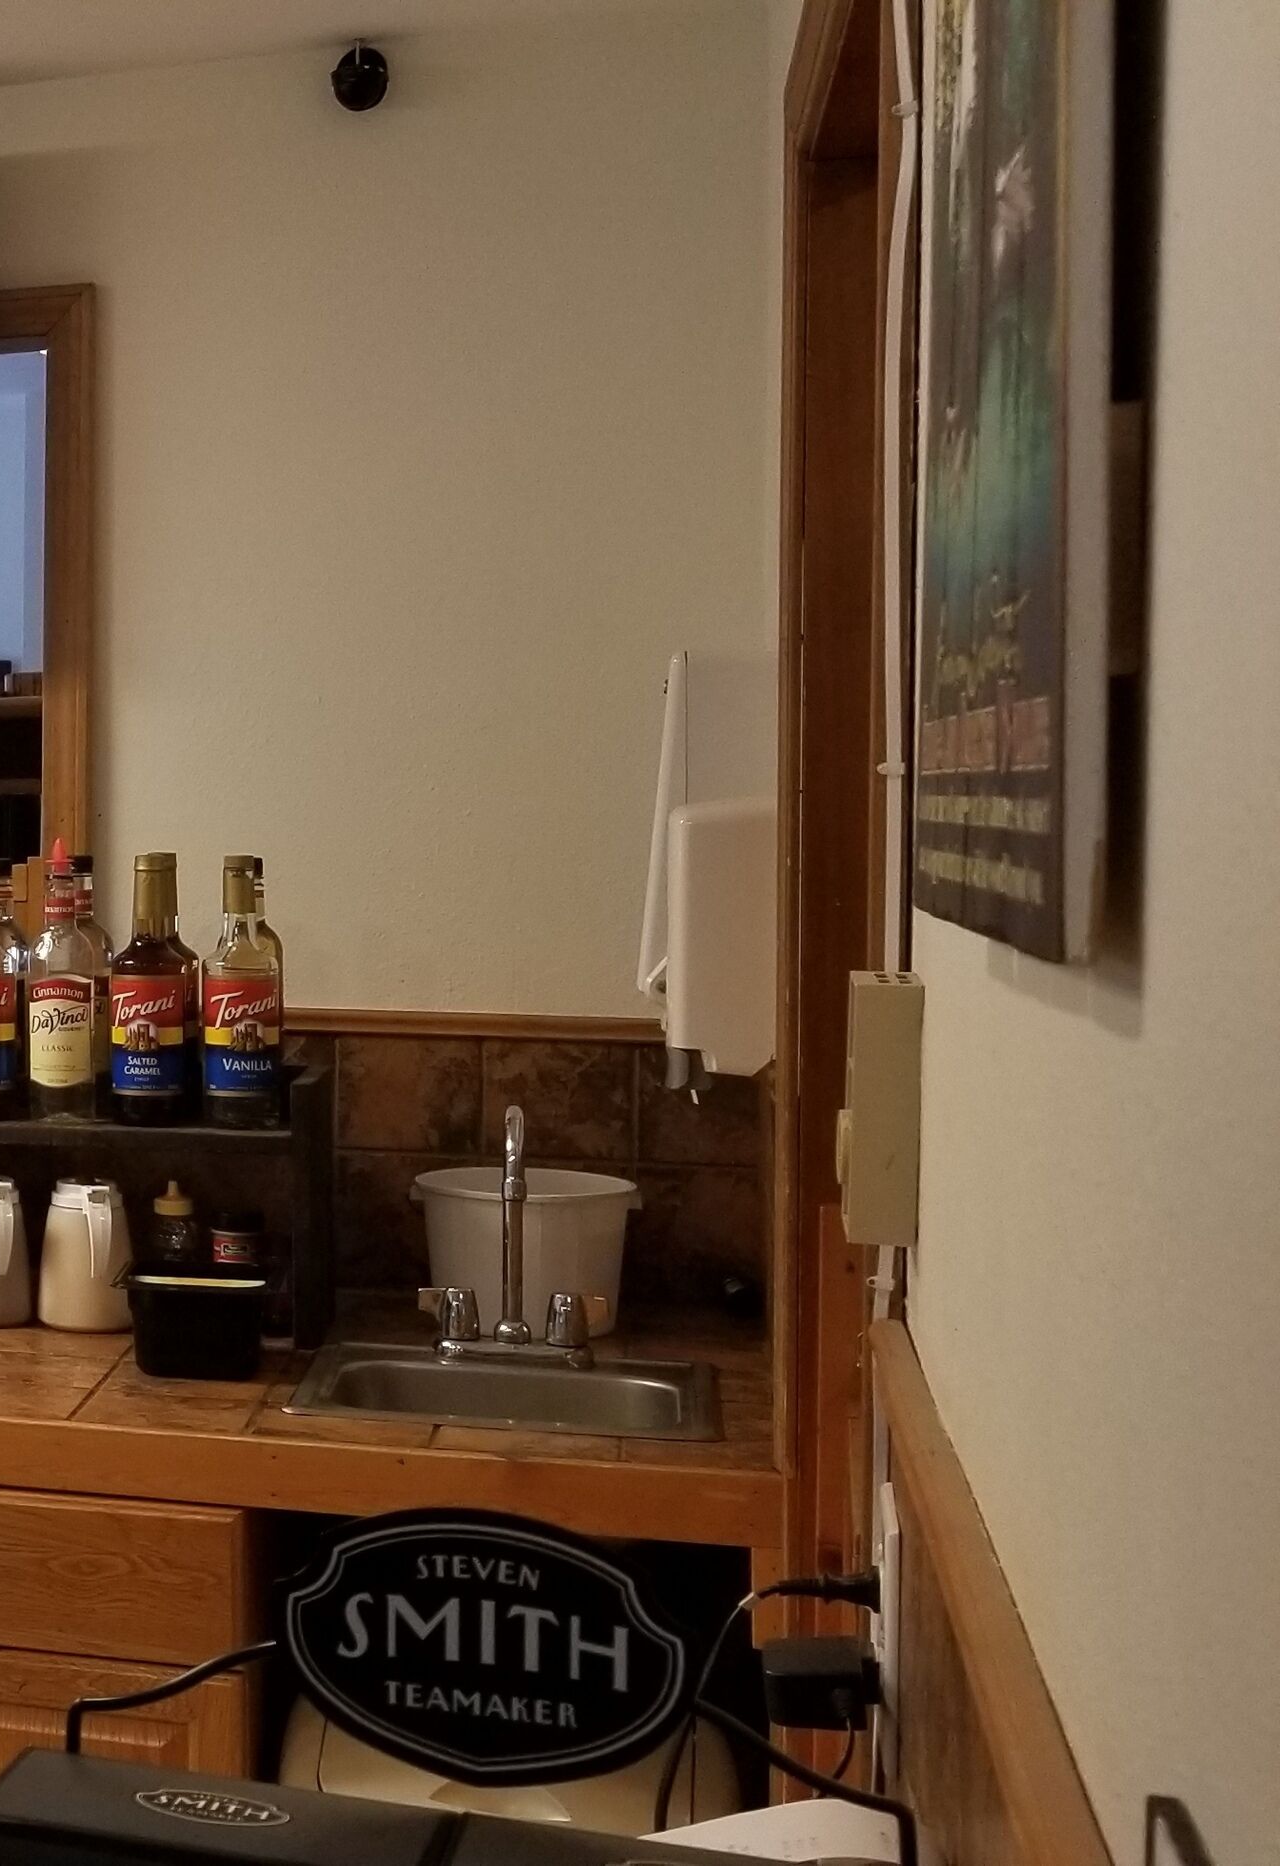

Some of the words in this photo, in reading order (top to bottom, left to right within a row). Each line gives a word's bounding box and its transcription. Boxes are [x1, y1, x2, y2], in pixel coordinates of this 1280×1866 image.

[32, 987, 85, 1000] Cinnamon
[112, 989, 176, 1028] Torani
[210, 989, 278, 1030] Torani
[124, 1065, 161, 1077] CARAMEL
[127, 1055, 158, 1067] SALTED
[222, 1058, 273, 1072] VANILLA
[416, 1554, 541, 1590] STEVEN
[336, 1592, 630, 1693] SMITH
[383, 1679, 578, 1729] TEAMAKER
[153, 1795, 270, 1820] SMITH
